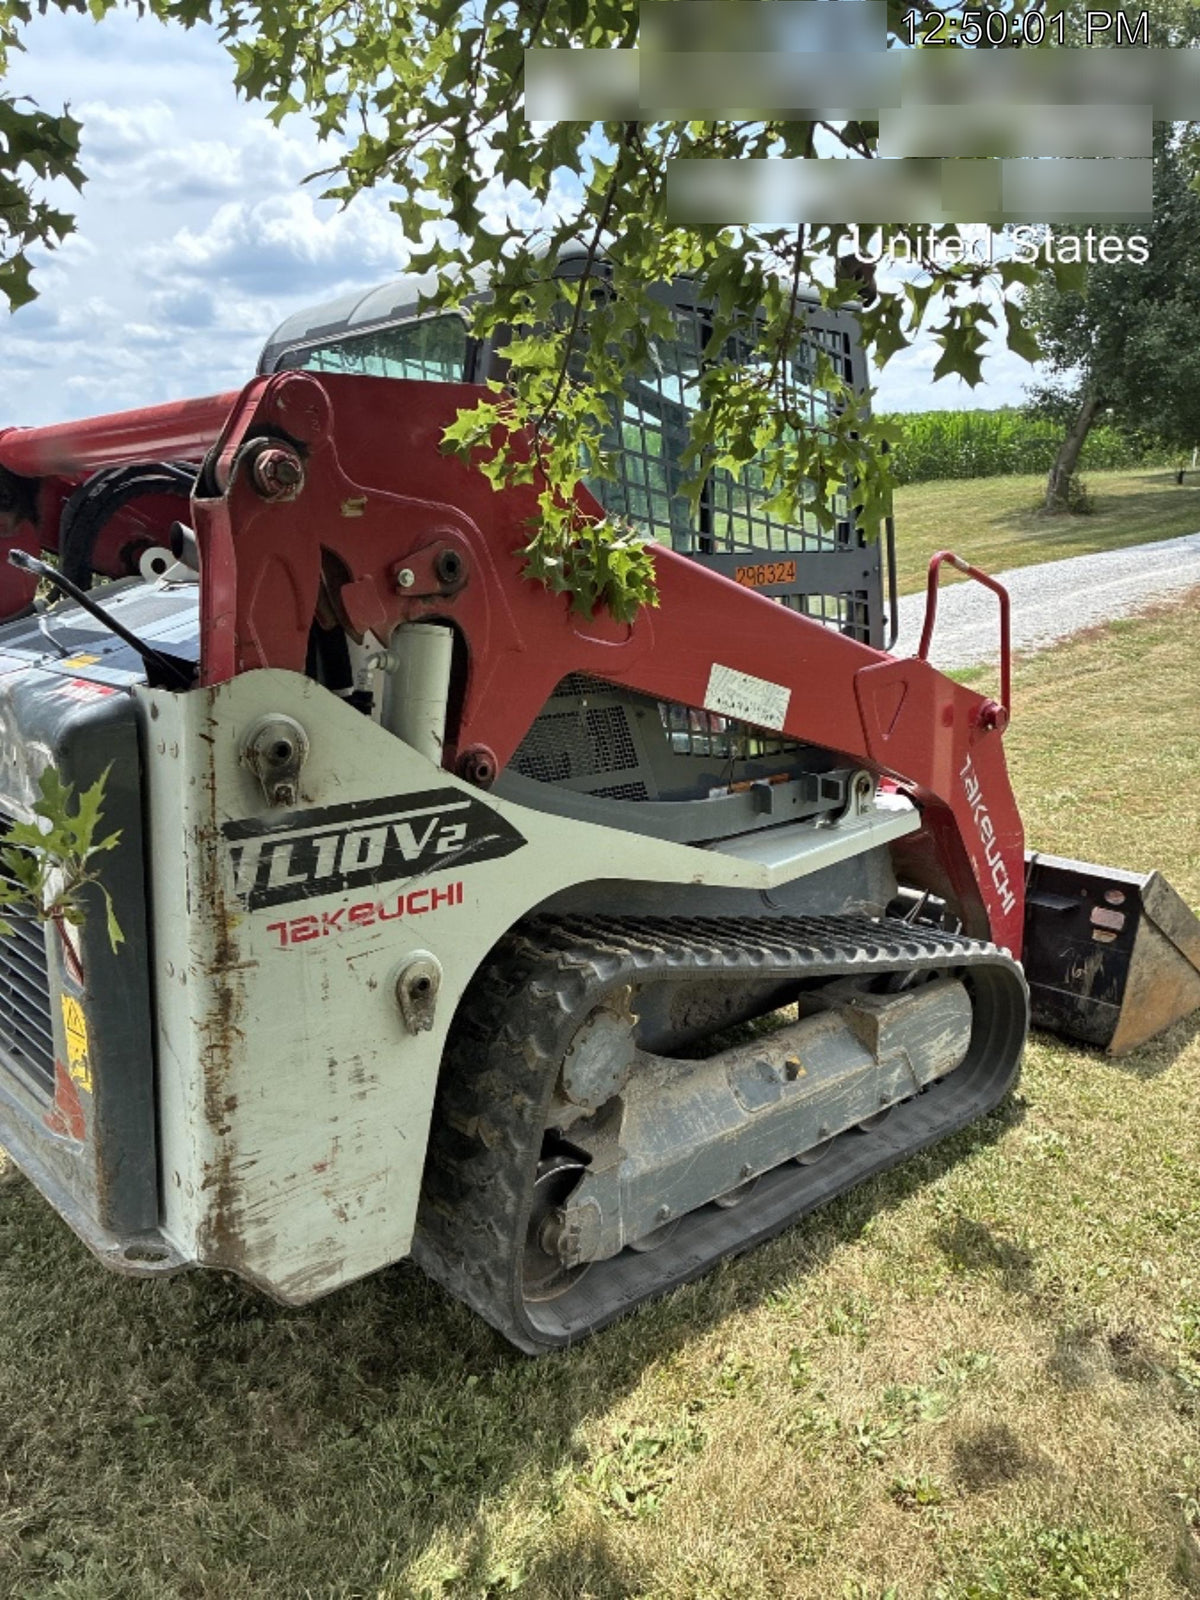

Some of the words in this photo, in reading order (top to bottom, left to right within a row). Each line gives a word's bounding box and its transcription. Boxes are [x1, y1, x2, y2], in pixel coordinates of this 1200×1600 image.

[736, 561, 795, 585] 296324
[227, 816, 468, 895] TL10V2
[960, 753, 1016, 917] TAKEUCHI
[266, 881, 464, 946] TAKEUCHI
